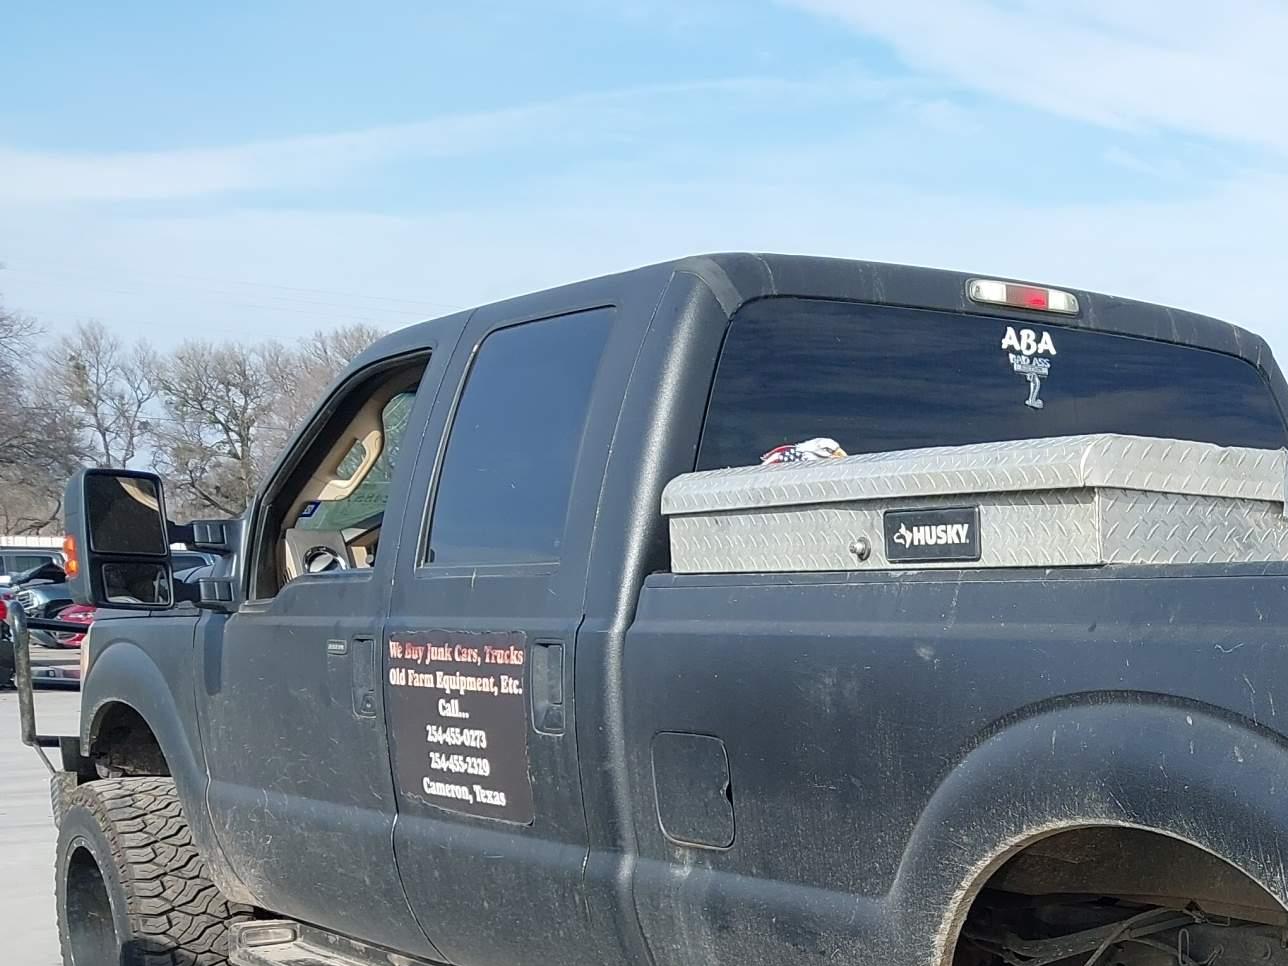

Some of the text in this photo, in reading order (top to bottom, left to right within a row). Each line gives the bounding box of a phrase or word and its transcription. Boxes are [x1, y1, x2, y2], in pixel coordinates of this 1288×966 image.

[1001, 326, 1057, 355] ABA
[1032, 356, 1051, 368] ASS
[912, 523, 969, 546] HUSKY
[389, 640, 524, 666] We Buy Junk Cars, Trucks
[389, 668, 523, 696] Old Farm Equipment, Etc.
[438, 699, 470, 719] Call...
[426, 725, 487, 748] 254-455-0273
[429, 752, 491, 776] 254-455-2329
[422, 777, 507, 806] Cameron, Texas
